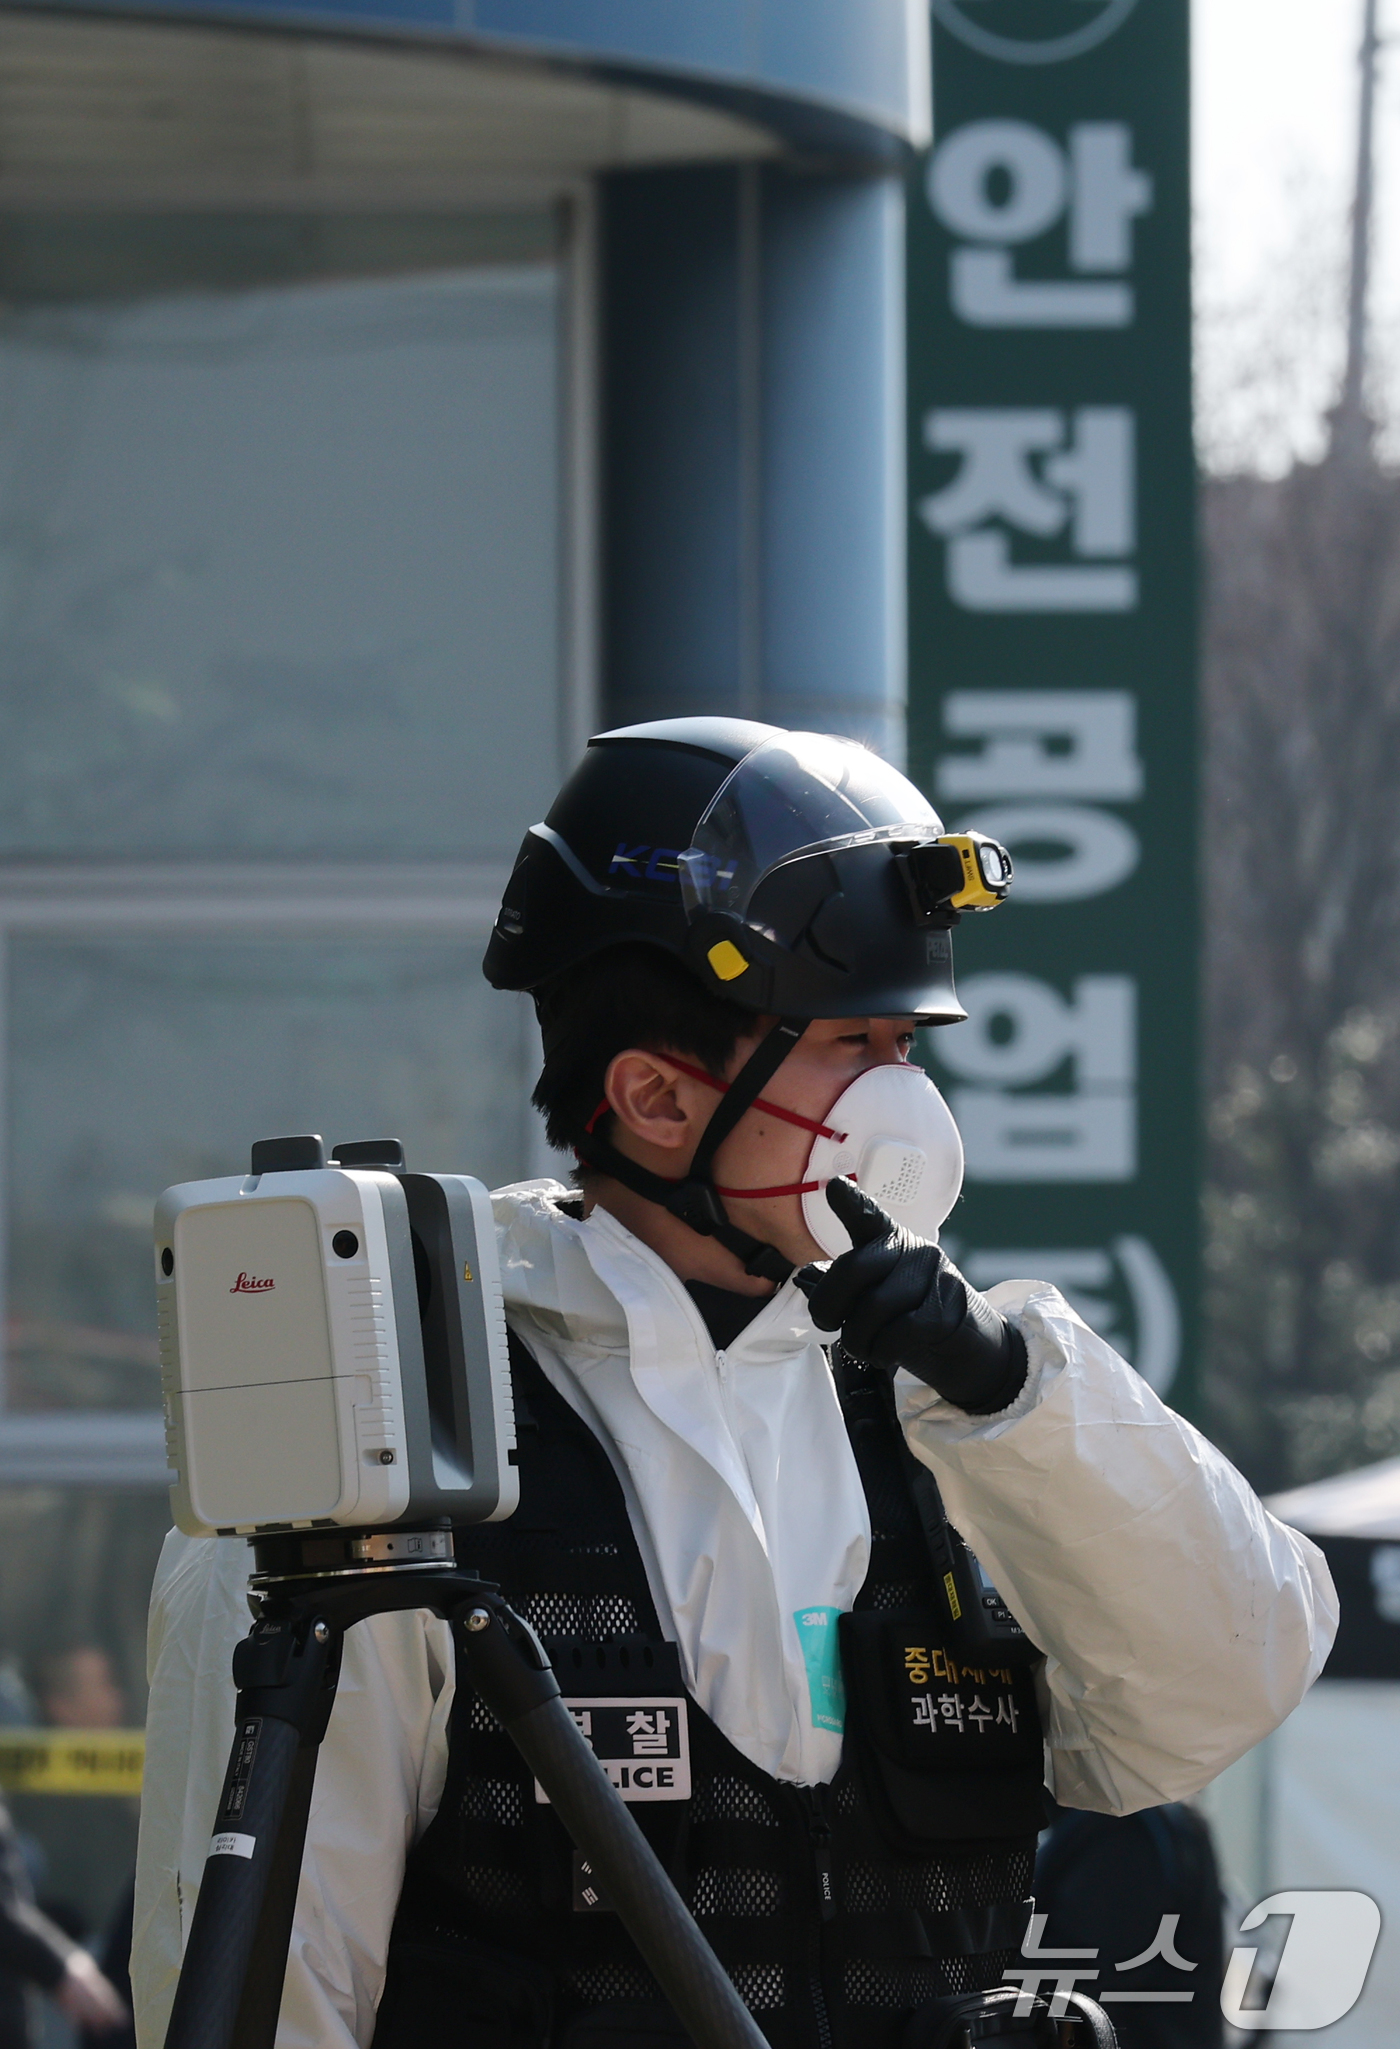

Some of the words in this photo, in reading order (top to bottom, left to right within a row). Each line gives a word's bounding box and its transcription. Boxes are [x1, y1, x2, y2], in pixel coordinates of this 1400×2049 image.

[921, 118, 1152, 1182] 안전공업
[229, 1271, 276, 1294] Leica
[802, 1612, 828, 1627] 3M
[911, 1692, 1020, 1734] 과학수사
[821, 1872, 832, 1901] POLICE
